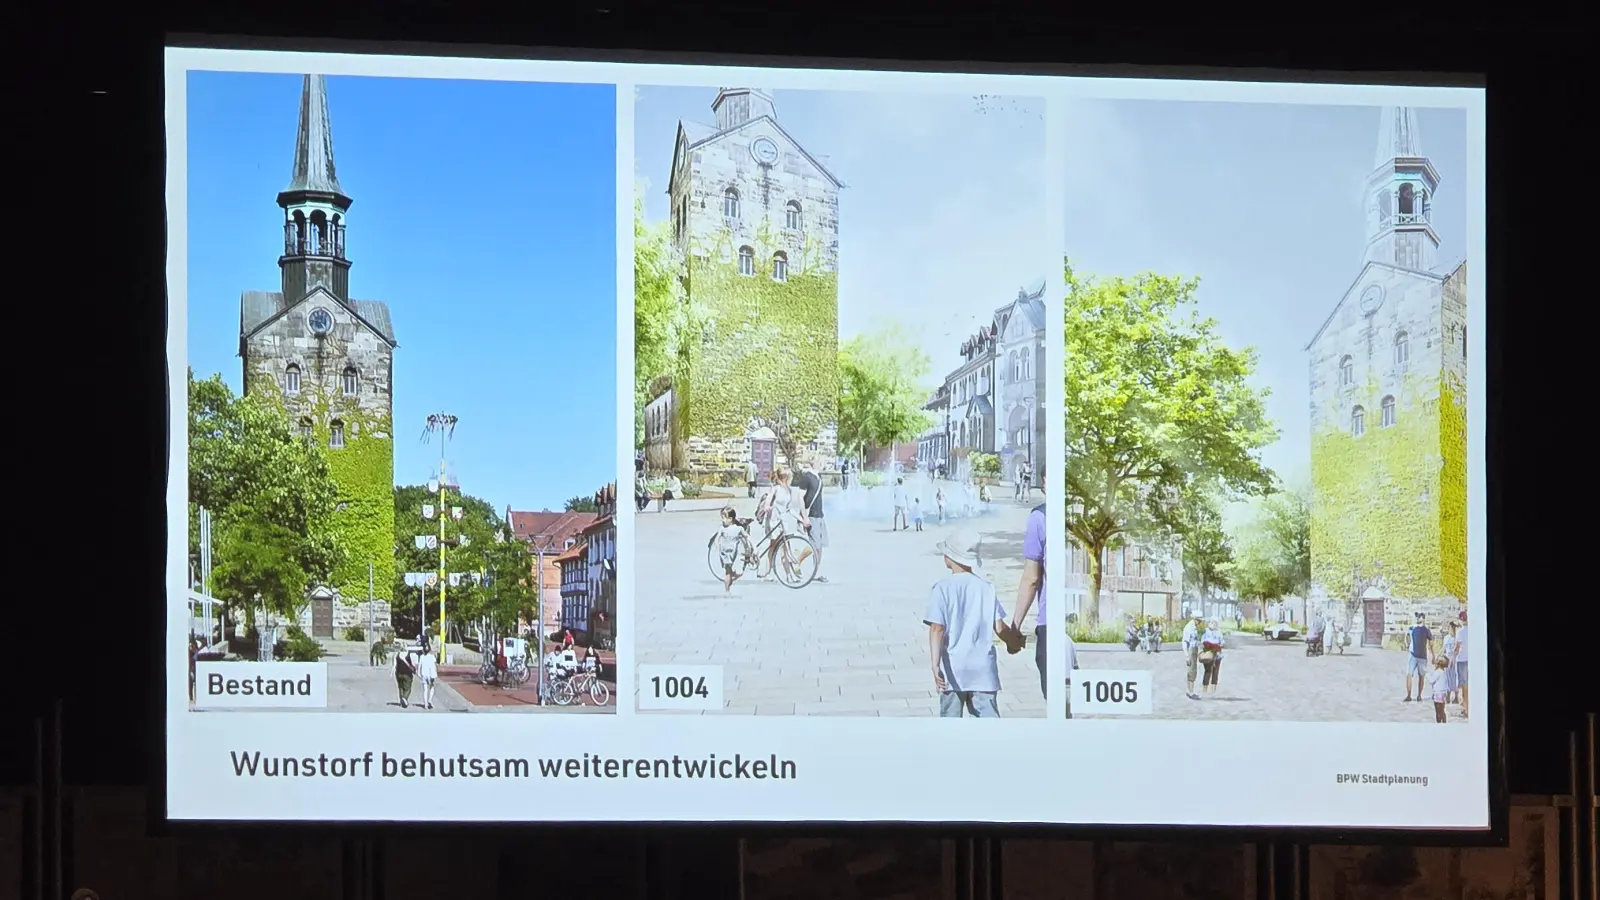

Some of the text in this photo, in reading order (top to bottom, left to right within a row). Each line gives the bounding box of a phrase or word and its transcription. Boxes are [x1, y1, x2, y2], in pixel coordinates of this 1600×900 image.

[208, 673, 311, 696] Bestand
[651, 676, 709, 699] 1004
[1082, 681, 1138, 703] 1005
[230, 751, 796, 779] Wunstorf behutsam weiterentwickeln
[1336, 773, 1429, 787] BPW Stadtplanung
